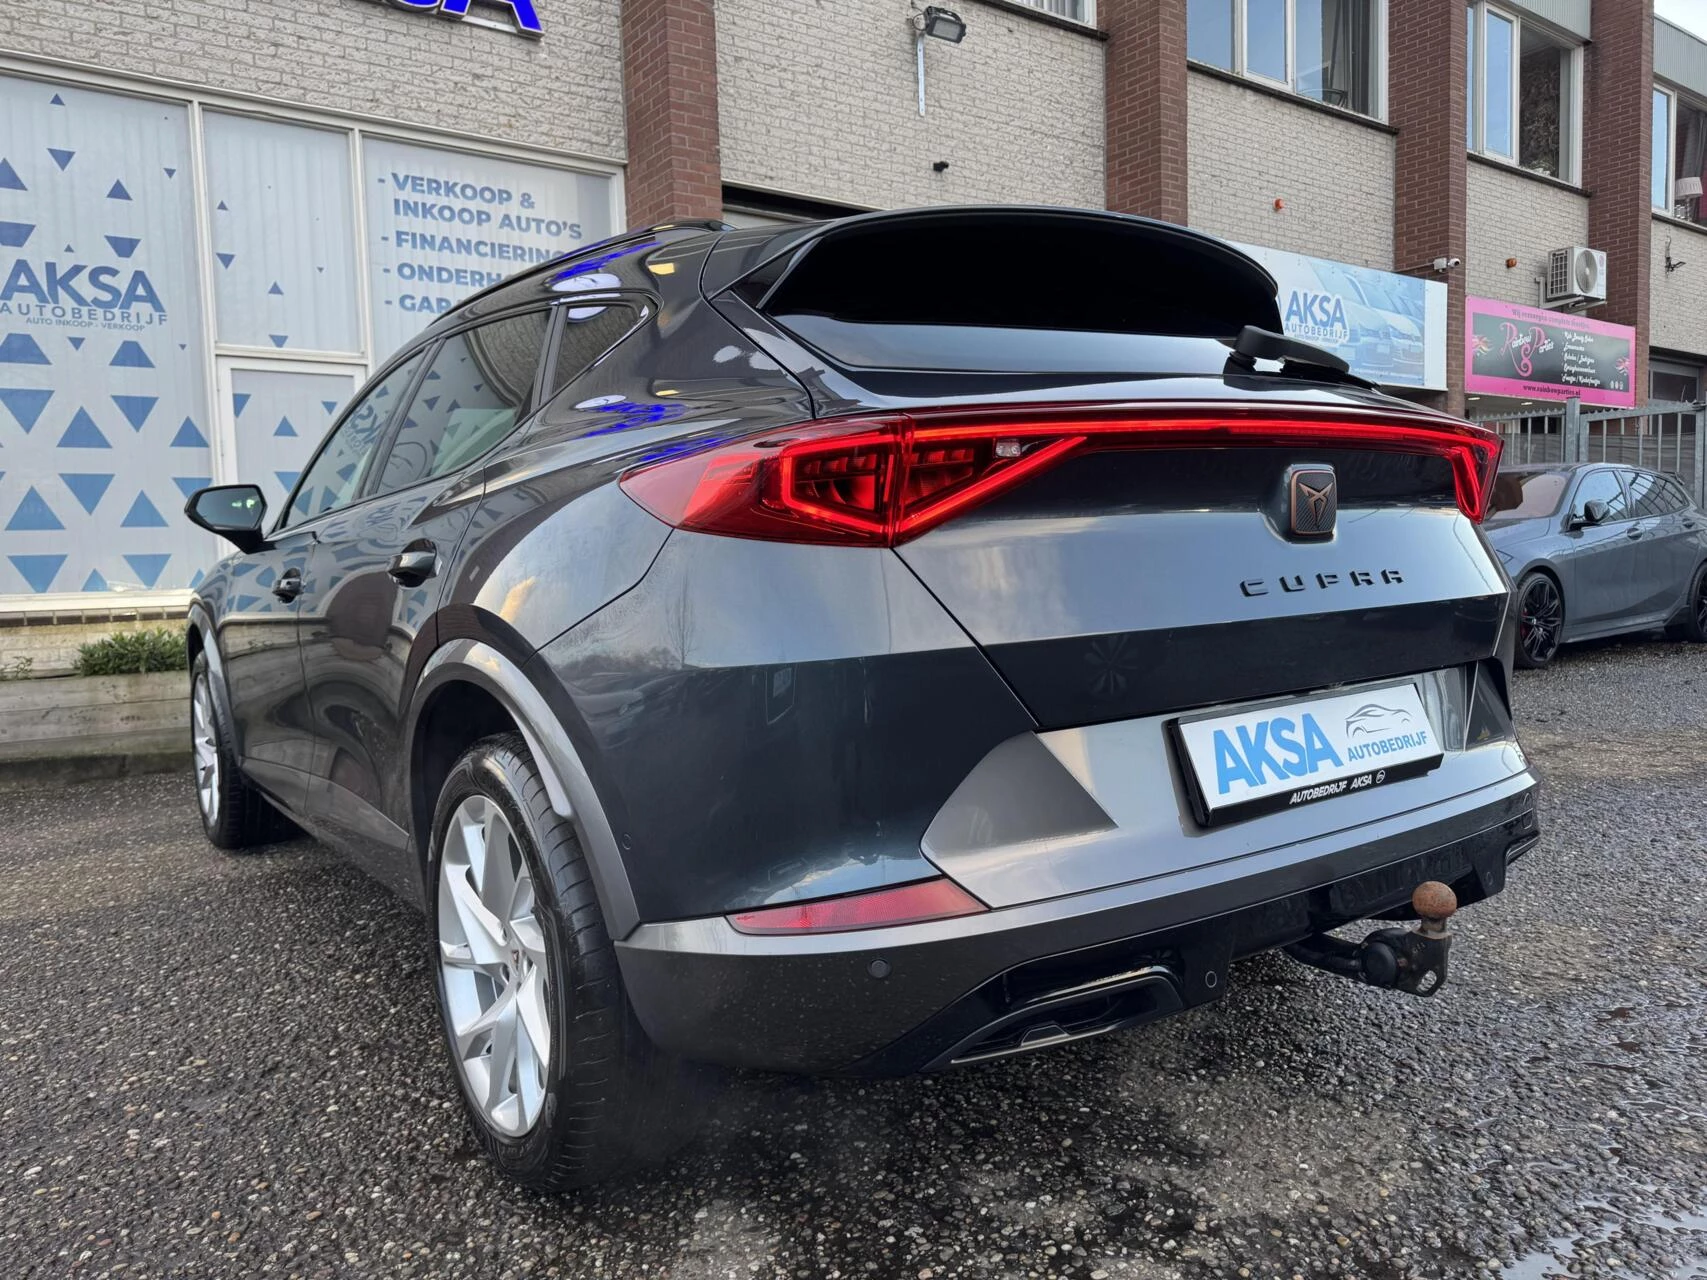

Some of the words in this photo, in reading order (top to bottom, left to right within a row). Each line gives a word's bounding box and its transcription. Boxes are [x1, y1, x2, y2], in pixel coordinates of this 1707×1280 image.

[391, 173, 513, 206] VERKOOP
[393, 198, 492, 227] INKOOP
[0, 258, 166, 313] AKSA
[0, 302, 168, 326] AUTOBEDRIJF
[26, 317, 53, 326] AUTO
[55, 319, 94, 329] INKOOP
[101, 323, 146, 332] VERKOOP
[1285, 290, 1348, 330] AKSA
[1284, 323, 1349, 340] AUTOBEDRIJF
[1239, 569, 1404, 598] CUPRA
[1213, 713, 1344, 795] AKSA
[1347, 731, 1428, 762] AUTOBEDRIJF
[1289, 781, 1348, 804] AUTOBEDRIJF
[1350, 774, 1372, 789] AKSA
